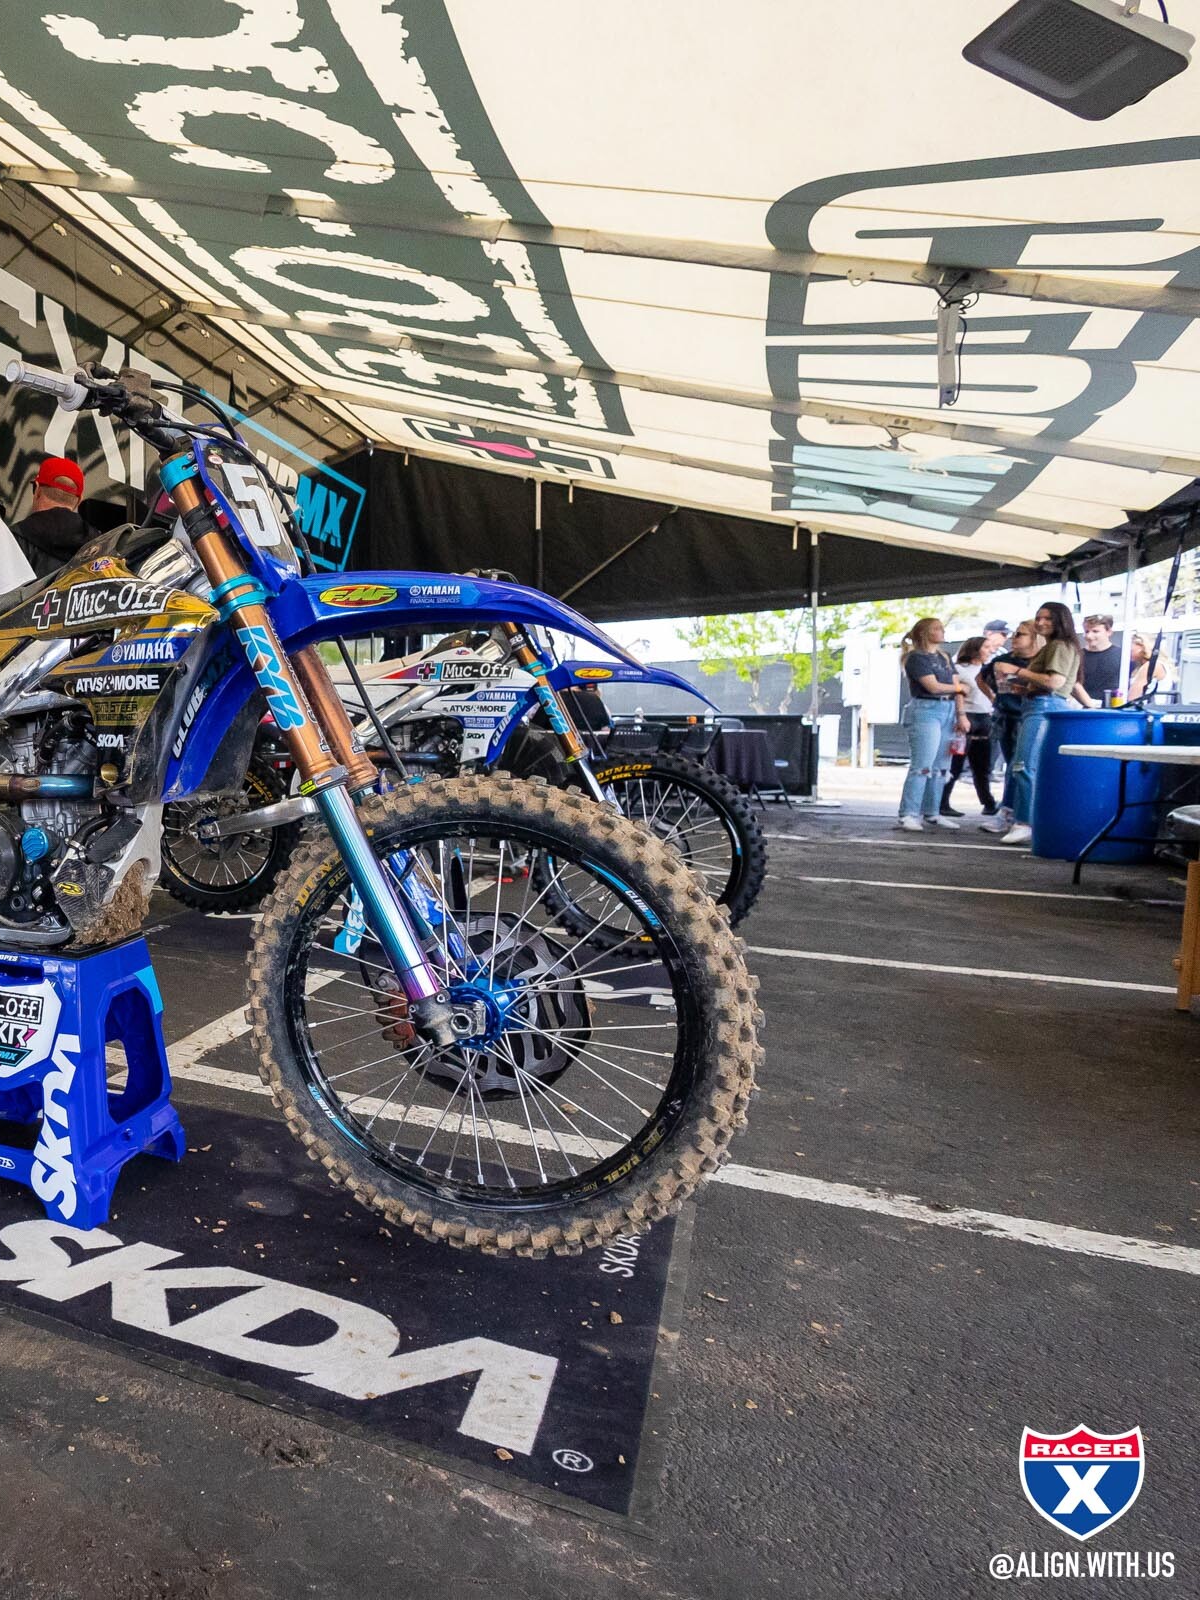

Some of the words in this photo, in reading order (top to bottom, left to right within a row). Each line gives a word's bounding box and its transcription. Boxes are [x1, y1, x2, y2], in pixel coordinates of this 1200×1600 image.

[221, 462, 281, 547] 5
[322, 586, 398, 603] FMF
[421, 586, 461, 596] YAMAHA
[68, 582, 168, 622] Muc-Off
[123, 643, 175, 661] YAMAHA
[236, 625, 307, 732] KYB
[444, 663, 511, 679] Muc-Off
[484, 691, 517, 701] YAMAHA
[595, 763, 653, 782] DUNLOP
